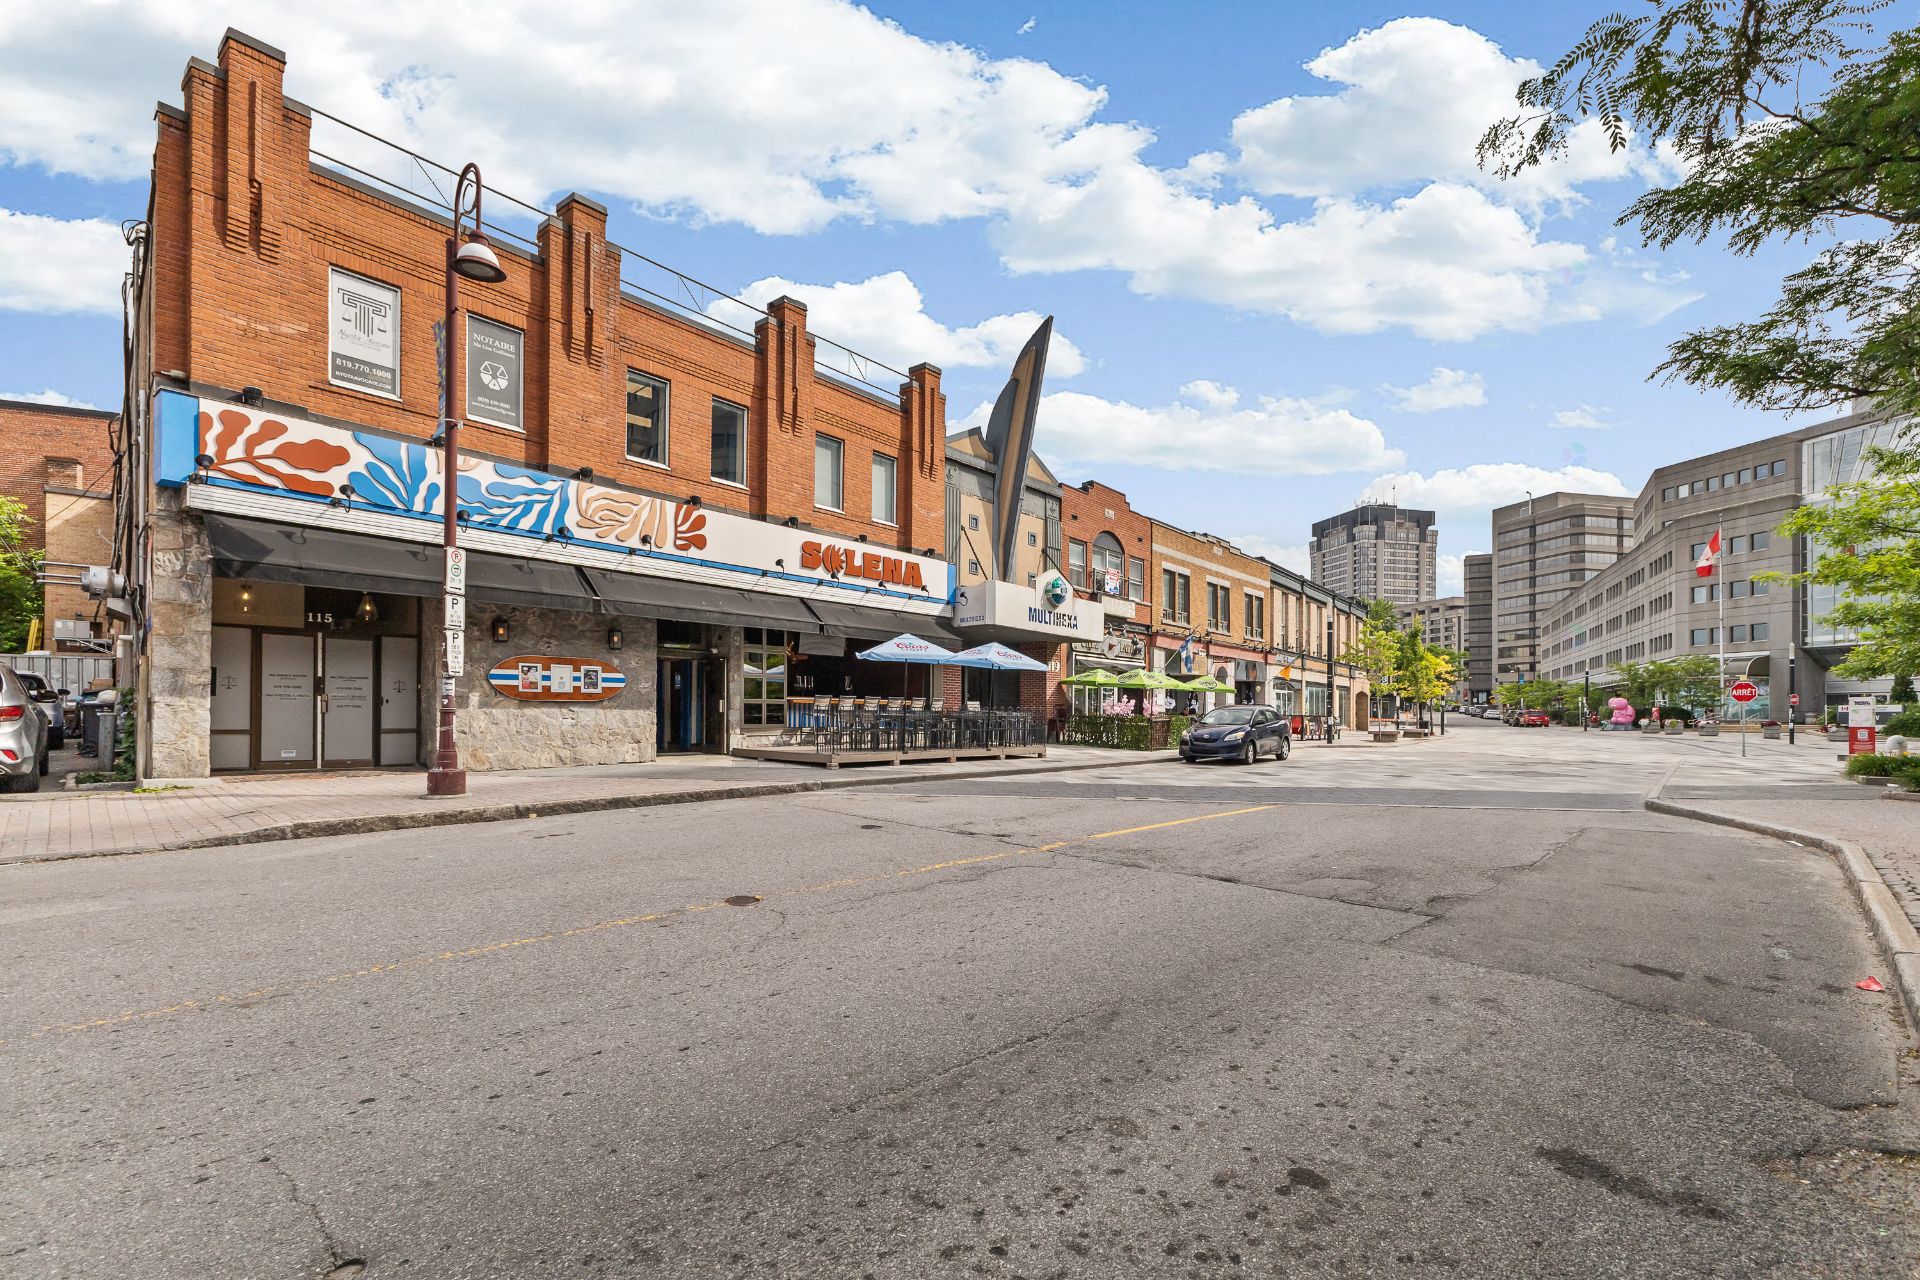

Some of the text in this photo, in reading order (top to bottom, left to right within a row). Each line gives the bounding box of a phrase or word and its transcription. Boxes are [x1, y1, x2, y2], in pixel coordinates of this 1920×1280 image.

[473, 333, 516, 353] NOTAIRE
[801, 541, 923, 588] SOLENA
[307, 612, 334, 623] 115
[1028, 606, 1078, 630] MULTIHEXA
[895, 642, 929, 650] Coors
[1732, 688, 1756, 696] ARRÊT
